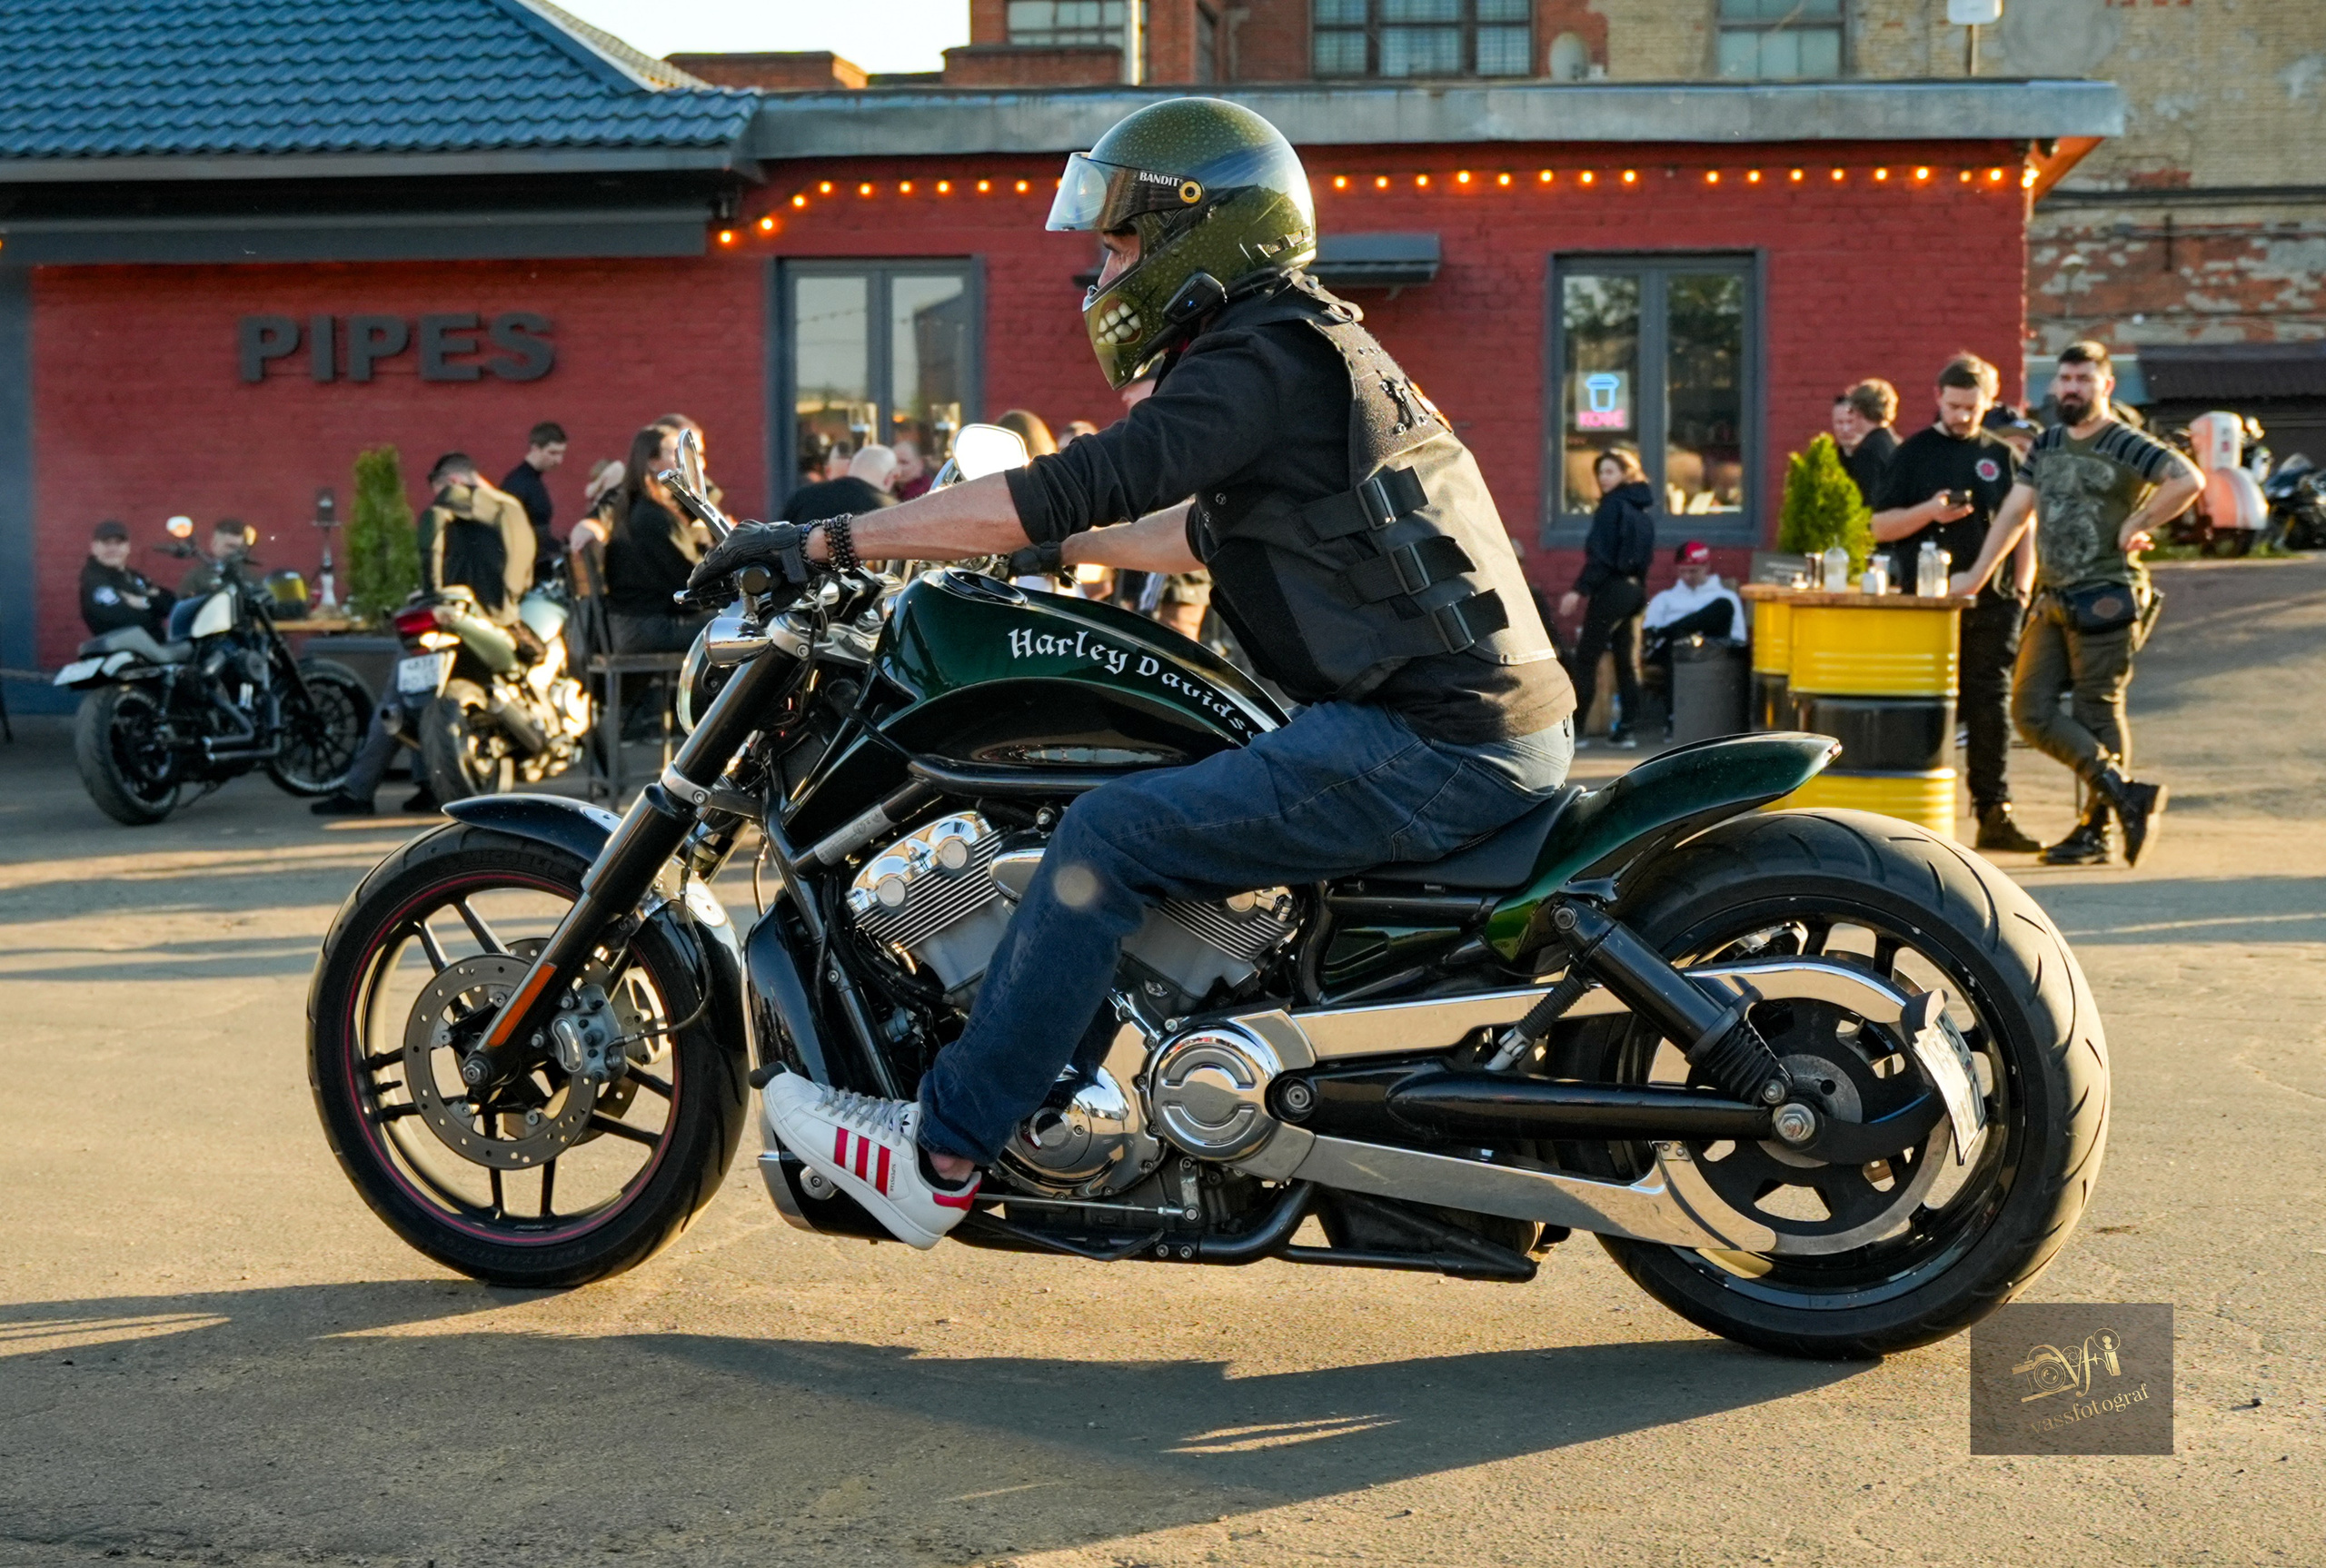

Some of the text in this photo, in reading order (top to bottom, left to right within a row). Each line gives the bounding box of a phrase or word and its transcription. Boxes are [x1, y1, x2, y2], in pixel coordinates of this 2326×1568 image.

[1139, 172, 1179, 186] BANDIT
[239, 311, 555, 383] PIPES
[1008, 629, 1128, 675] Harley
